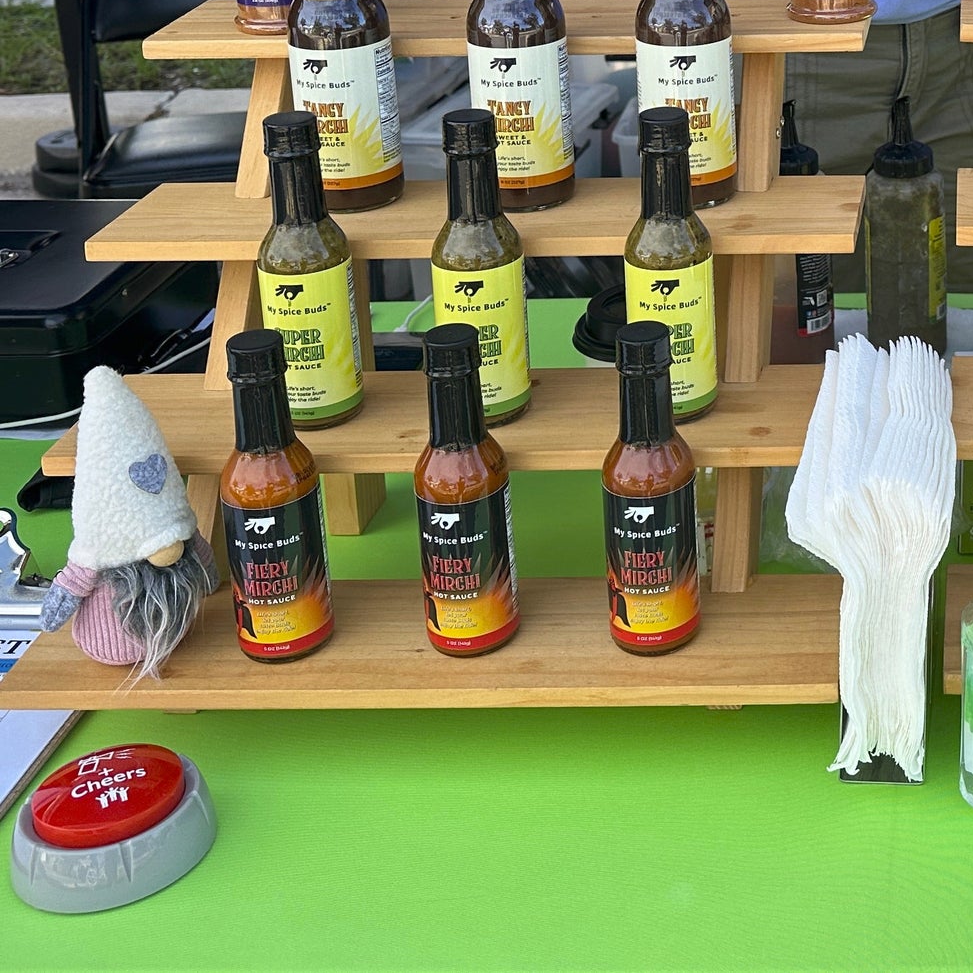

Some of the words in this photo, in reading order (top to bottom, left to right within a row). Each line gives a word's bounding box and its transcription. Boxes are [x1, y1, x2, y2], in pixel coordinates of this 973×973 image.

[306, 81, 326, 90] Spice
[480, 79, 491, 88] My
[492, 80, 514, 89] Spice
[658, 77, 669, 87] My
[671, 77, 694, 87] Spice
[487, 99, 532, 117] TANGY
[495, 117, 535, 133] IRCHI
[278, 307, 302, 316] Spice
[444, 302, 455, 313] My
[458, 304, 481, 313] Spice
[639, 301, 650, 311] My
[653, 303, 677, 312] Spice
[275, 327, 322, 345] UPER
[294, 363, 322, 371] SAUCE
[422, 531, 433, 543] My
[433, 536, 458, 546] Spice
[614, 527, 625, 539] My
[627, 530, 652, 540] Spice
[235, 539, 246, 550] My
[249, 542, 274, 551] Spice
[432, 555, 473, 573] FIERY
[623, 550, 665, 569] FIERY
[246, 561, 289, 580] FIERY
[620, 566, 673, 587] MIRCHI
[243, 575, 298, 597] MIRCHI
[430, 572, 482, 592] MIRCHI
[433, 592, 448, 600] HOT
[450, 592, 479, 600] SAUCE
[642, 586, 671, 595] SAUCE
[267, 595, 296, 605] SAUCE
[71, 767, 147, 799] Cheers
